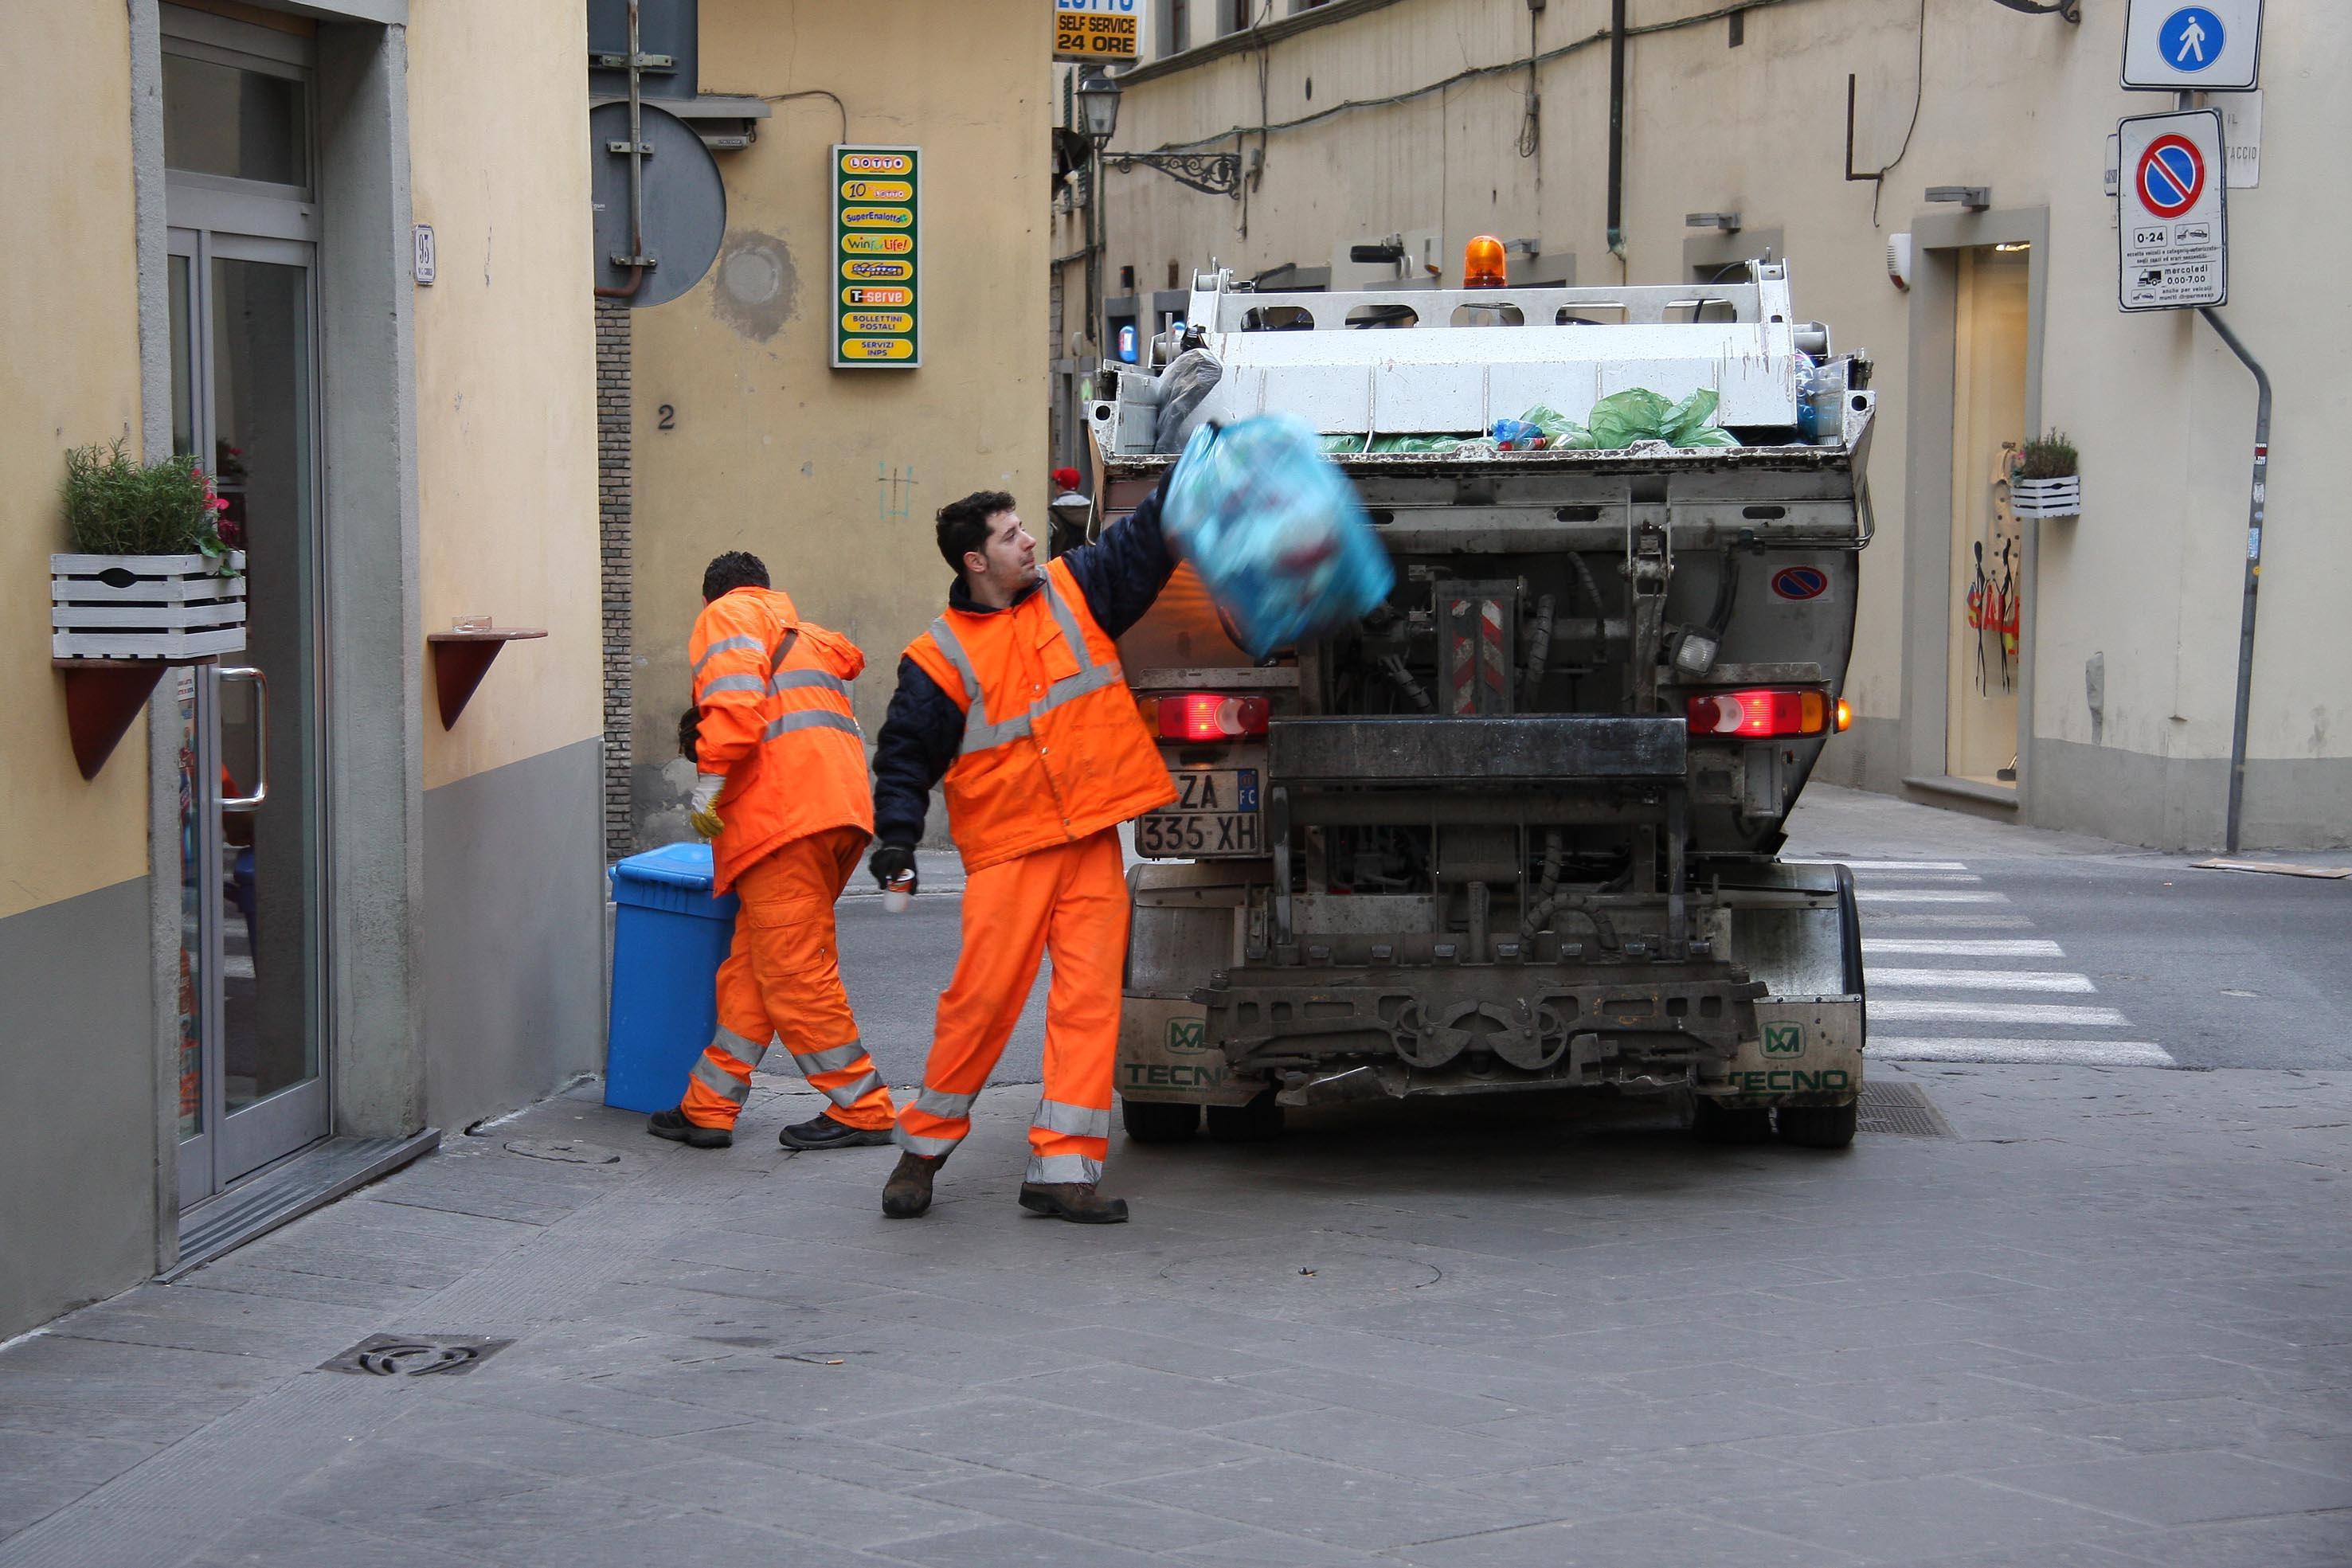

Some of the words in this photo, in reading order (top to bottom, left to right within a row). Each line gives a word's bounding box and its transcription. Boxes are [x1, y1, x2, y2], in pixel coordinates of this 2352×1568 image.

[1059, 15, 1086, 31] SELF
[1089, 17, 1135, 33] SERVICE
[1058, 34, 1085, 50] 24
[1092, 36, 1134, 53] ORE
[850, 157, 903, 169] LOTTO
[849, 182, 867, 197] 10
[846, 212, 901, 223] SuperEnalotto
[2137, 232, 2164, 243] 0-24
[419, 234, 430, 264] 93
[658, 405, 675, 430] 2
[1180, 775, 1218, 809] ZA
[1239, 789, 1255, 804] FC
[1145, 816, 1203, 850] 335
[1217, 815, 1256, 850] XH
[1124, 1064, 1231, 1086] TECN
